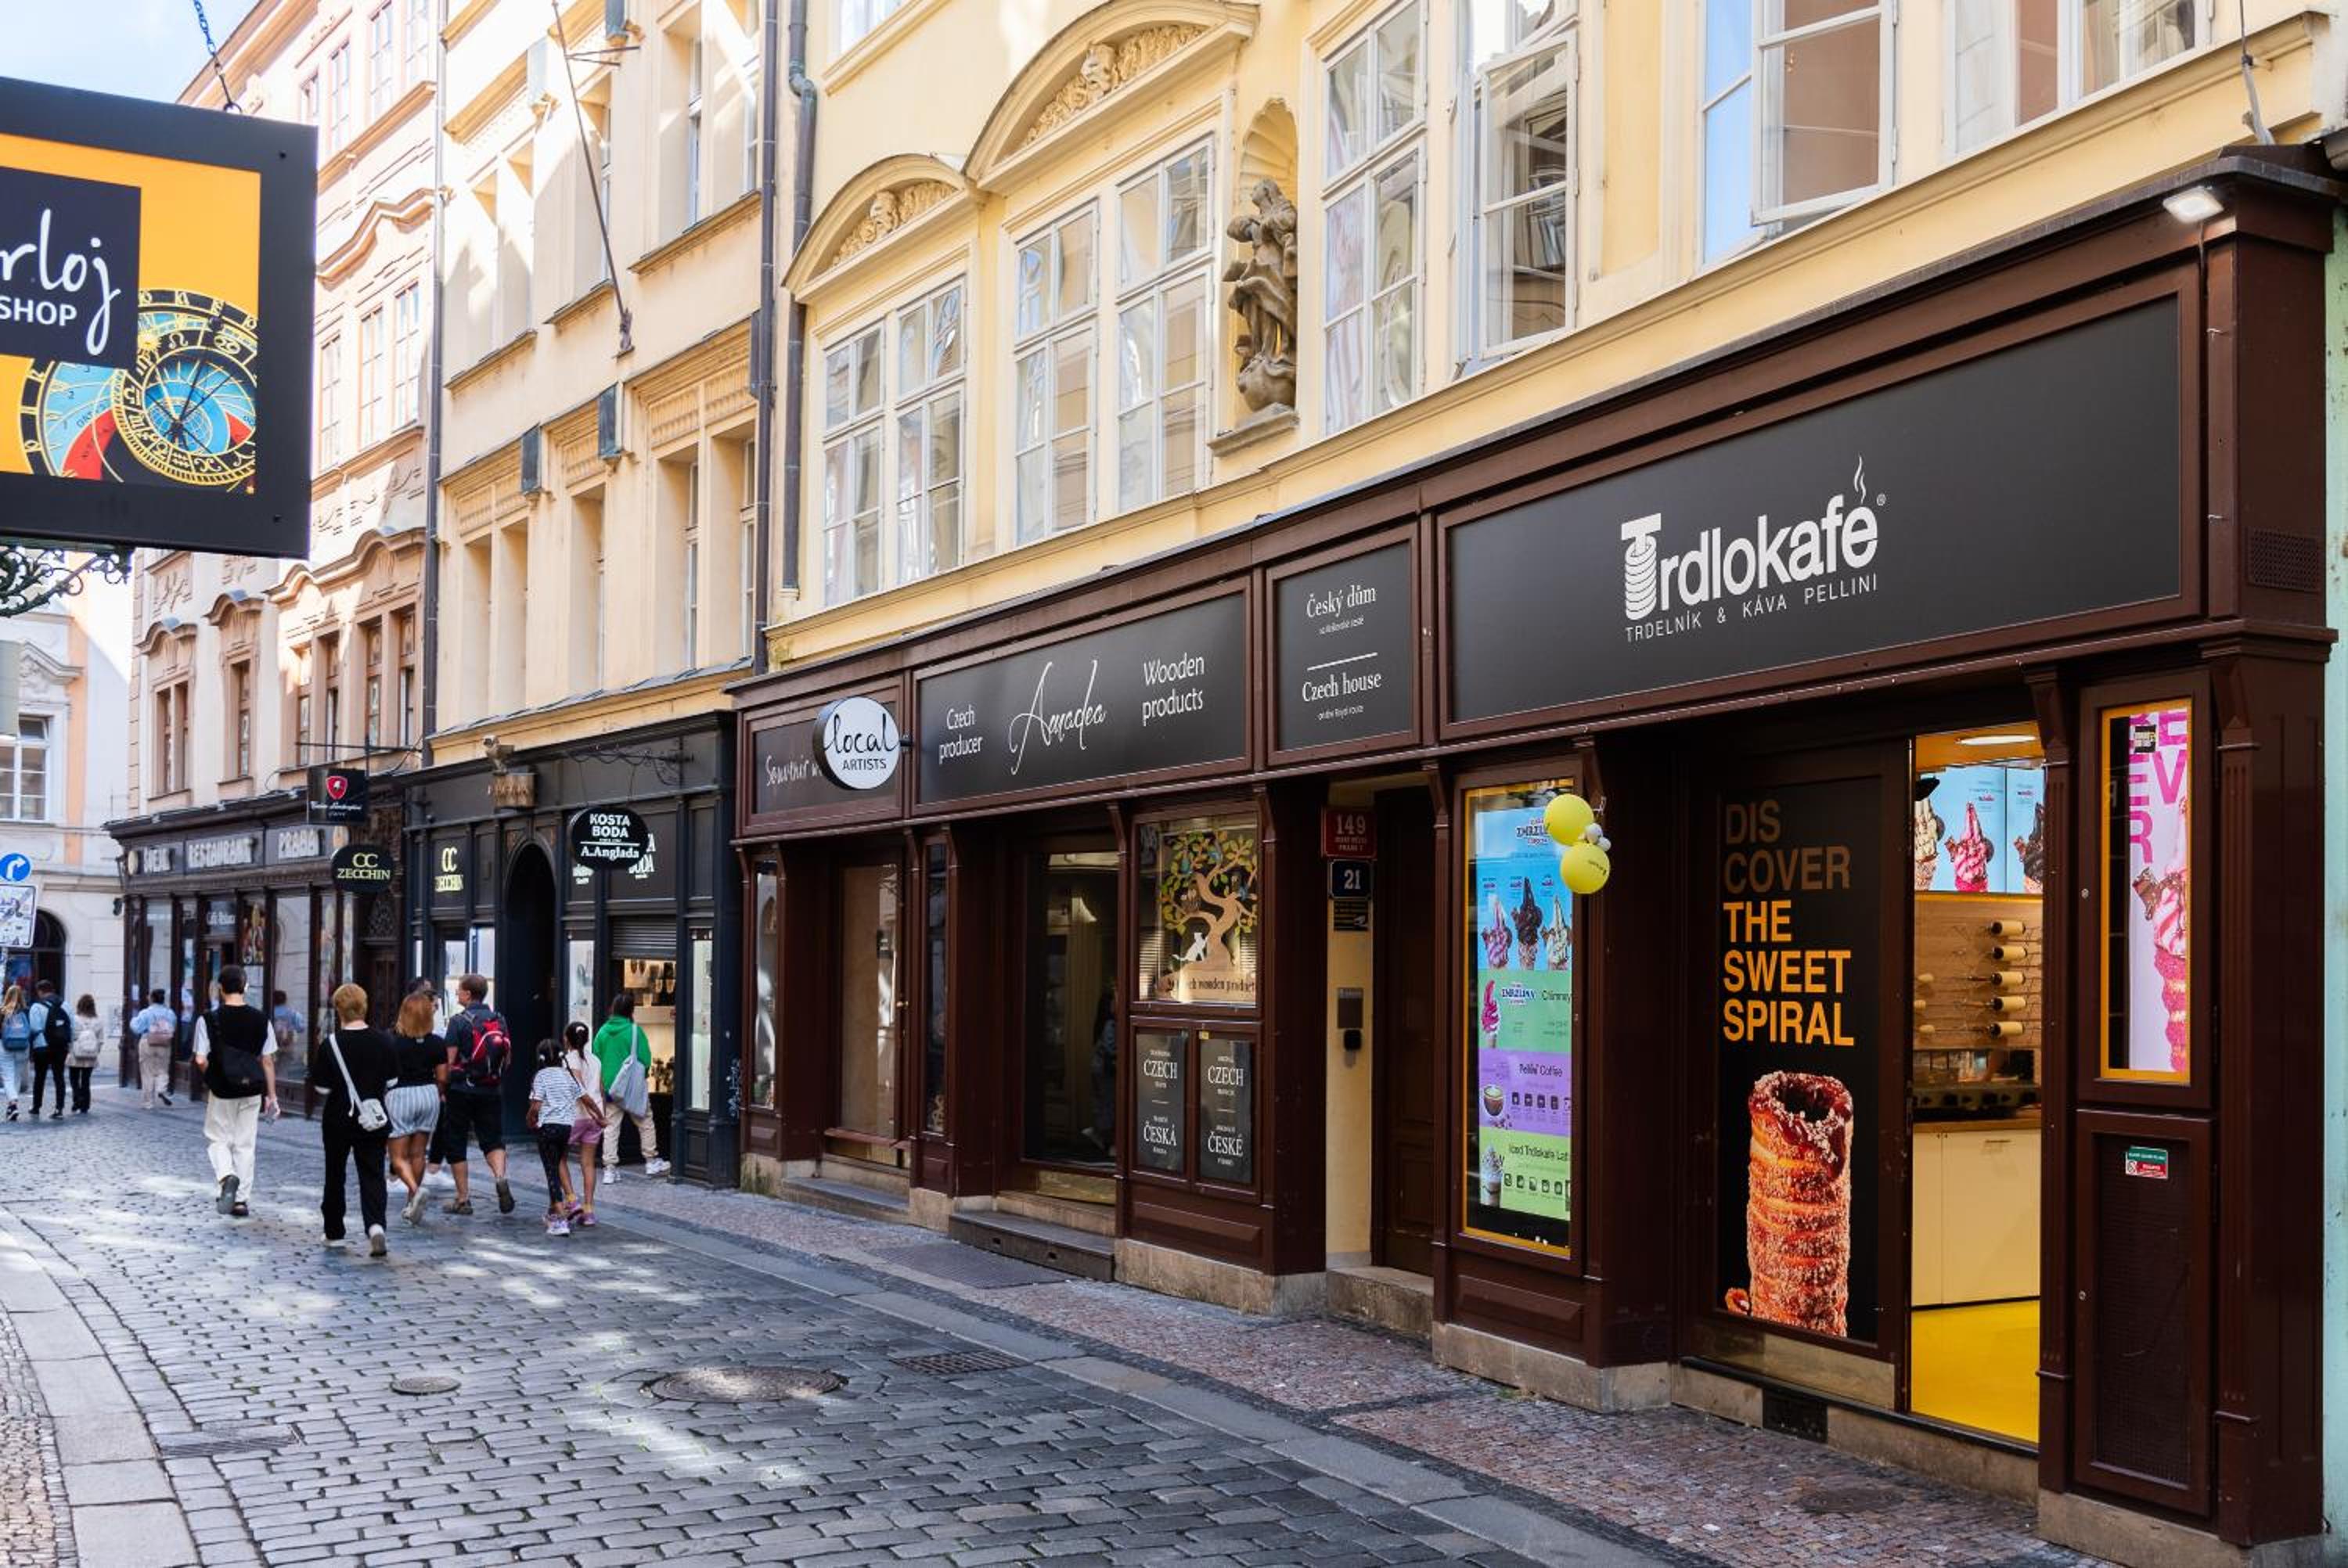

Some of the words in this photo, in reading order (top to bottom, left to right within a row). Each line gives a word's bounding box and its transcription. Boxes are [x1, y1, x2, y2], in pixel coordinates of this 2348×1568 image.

[0, 295, 77, 326] SHOP
[1306, 589, 1345, 618] Český
[1347, 584, 1377, 609] dům
[1626, 610, 1702, 643] TRDELNÍK
[1716, 607, 1727, 624] &
[1743, 594, 1788, 619] KÁVA
[1804, 572, 1878, 606] PELLINI
[1143, 651, 1205, 686] Wooden
[1302, 674, 1339, 703] Czech
[1342, 671, 1382, 695] house
[946, 704, 976, 729] Czech
[1008, 659, 1107, 776] Amadea
[1142, 687, 1205, 726] products
[824, 713, 899, 754] local
[938, 733, 983, 760] producer
[841, 757, 888, 771] ARTISTS
[589, 814, 631, 826] KOSTA
[592, 825, 629, 838] BODA
[1337, 815, 1367, 836] 149
[1725, 799, 1782, 846] DIS
[1343, 869, 1361, 890] 21
[1724, 845, 1852, 894] COVER
[1723, 899, 1792, 943] THE
[1723, 948, 1852, 994] SWEET
[1723, 998, 1856, 1047] SPIRAL
[1143, 1058, 1178, 1080] CZECH
[1207, 1064, 1244, 1087] CZECH
[1143, 1120, 1177, 1146] ČESKÁ
[1207, 1131, 1244, 1157] ČESKÉ
